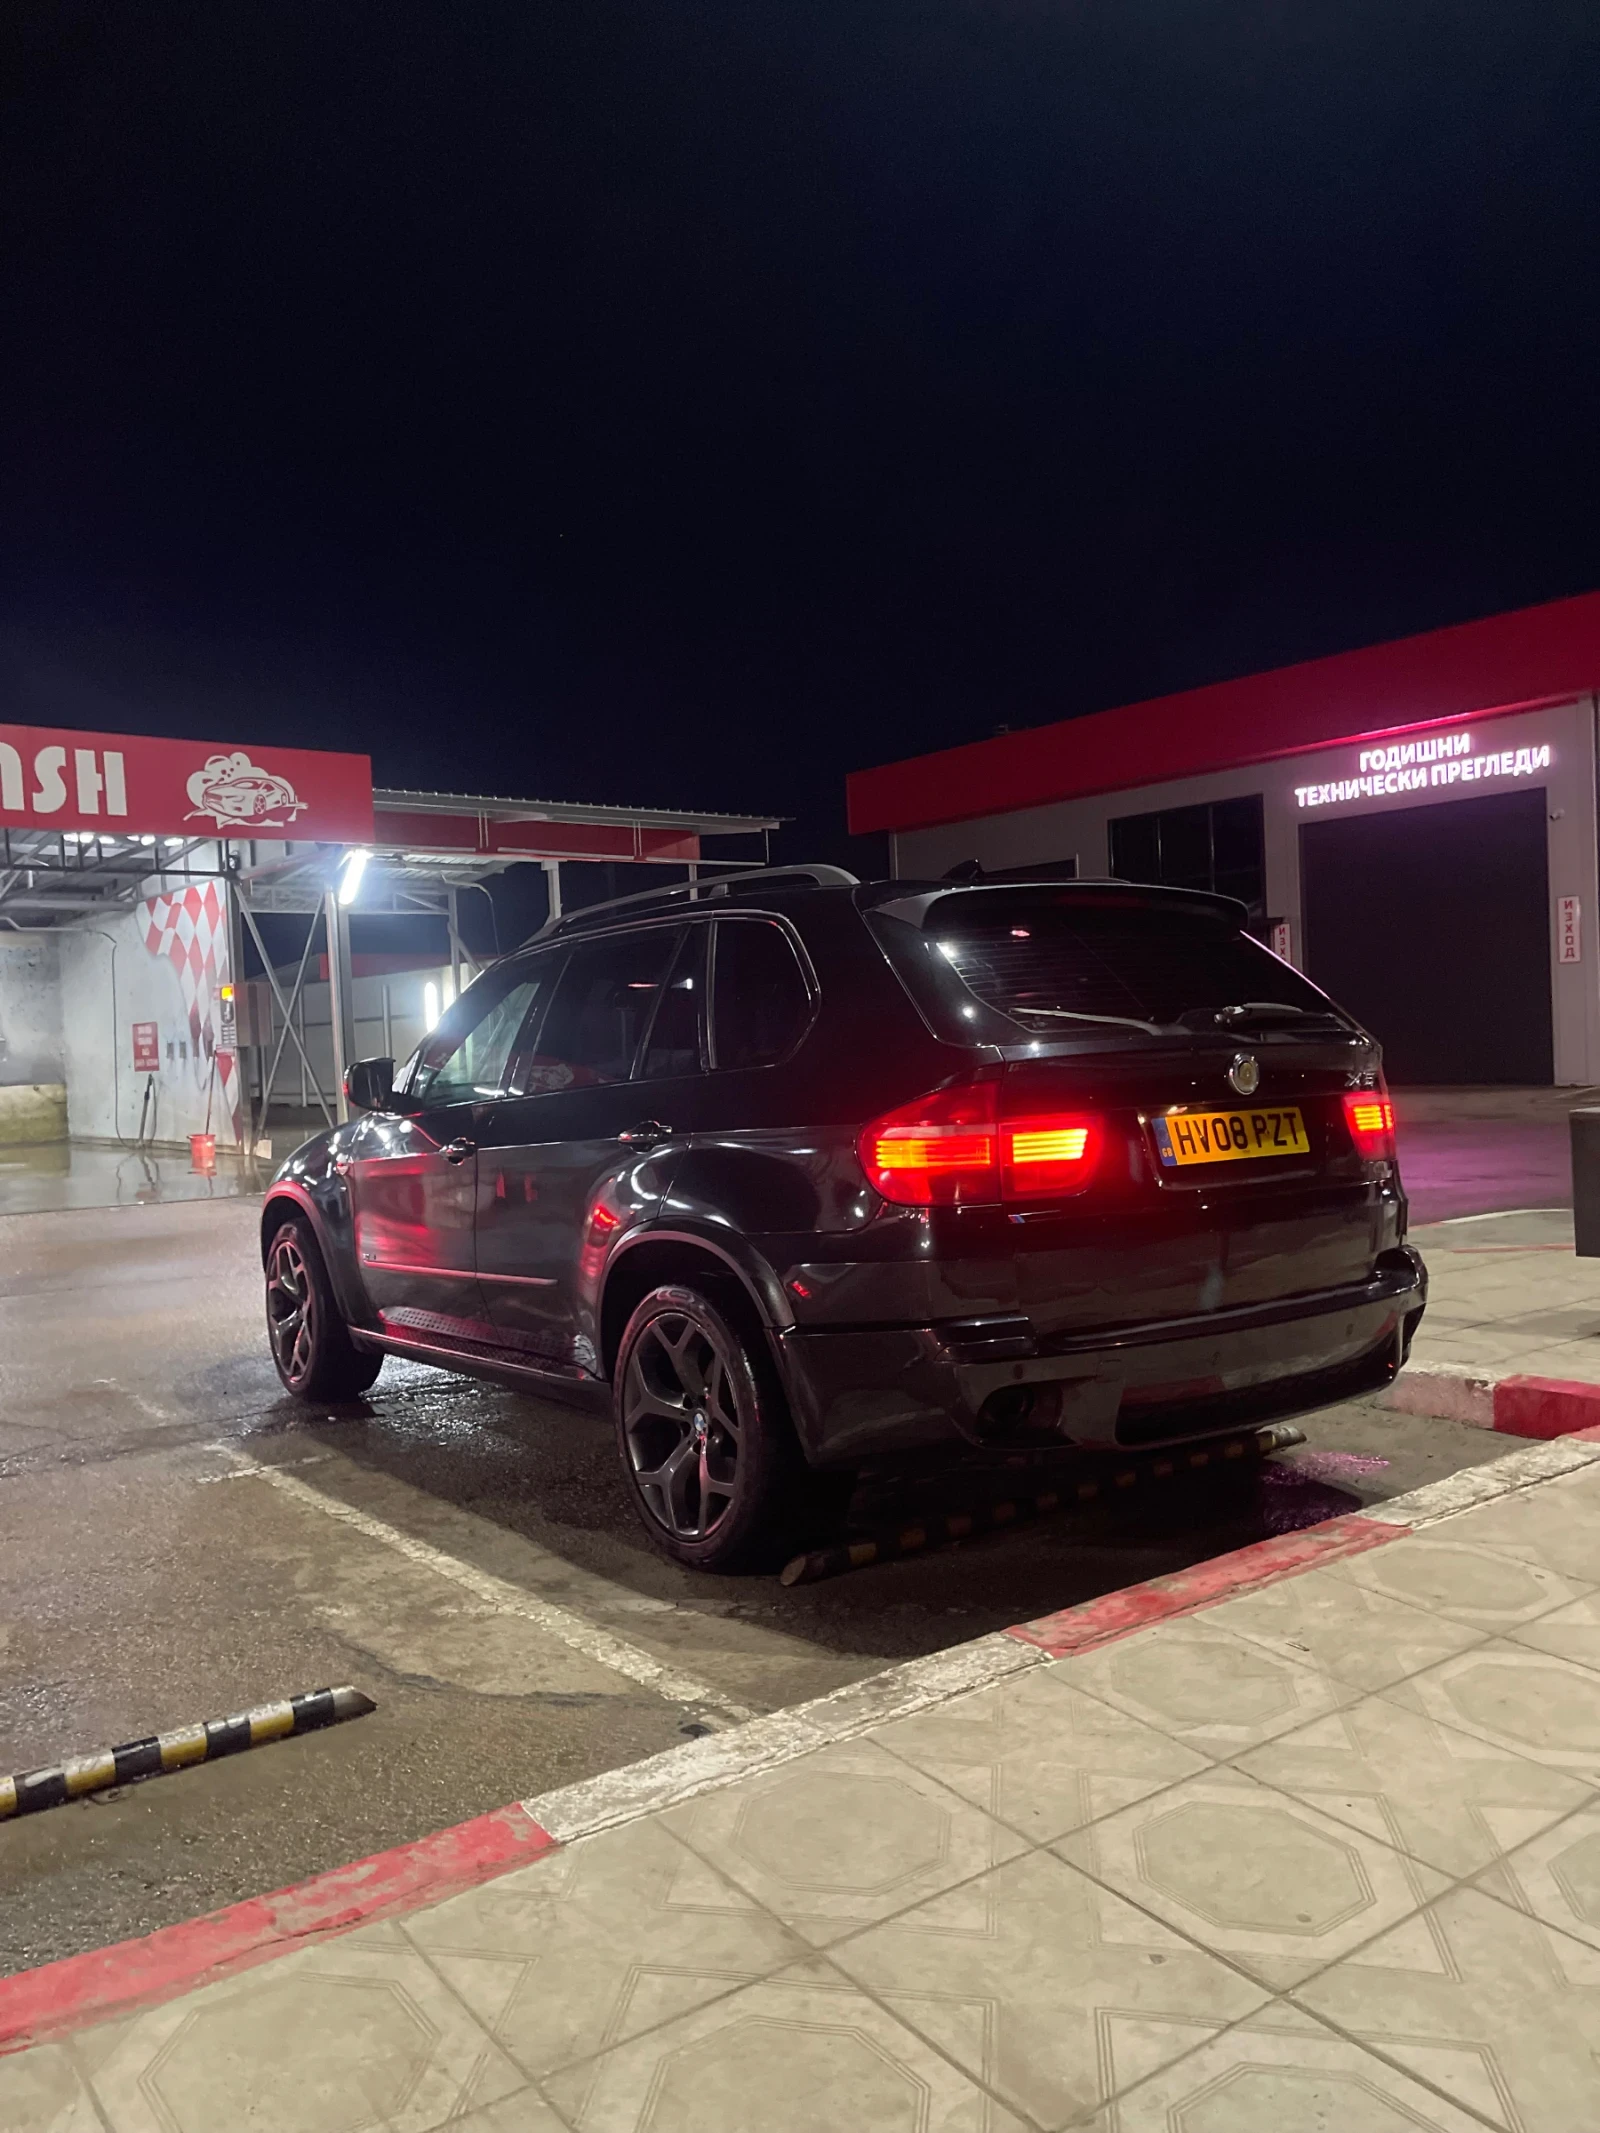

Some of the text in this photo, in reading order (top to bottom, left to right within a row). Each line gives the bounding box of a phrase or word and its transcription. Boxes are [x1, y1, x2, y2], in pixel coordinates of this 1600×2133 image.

[1294, 745, 1550, 807] ТЕХНИЧЕСКИ ПРЕГЛЕДИ
[1359, 733, 1470, 772] ГОДИШНИ
[1564, 900, 1575, 958] ИЗХОД
[1174, 1112, 1299, 1155] HV08 PZT
